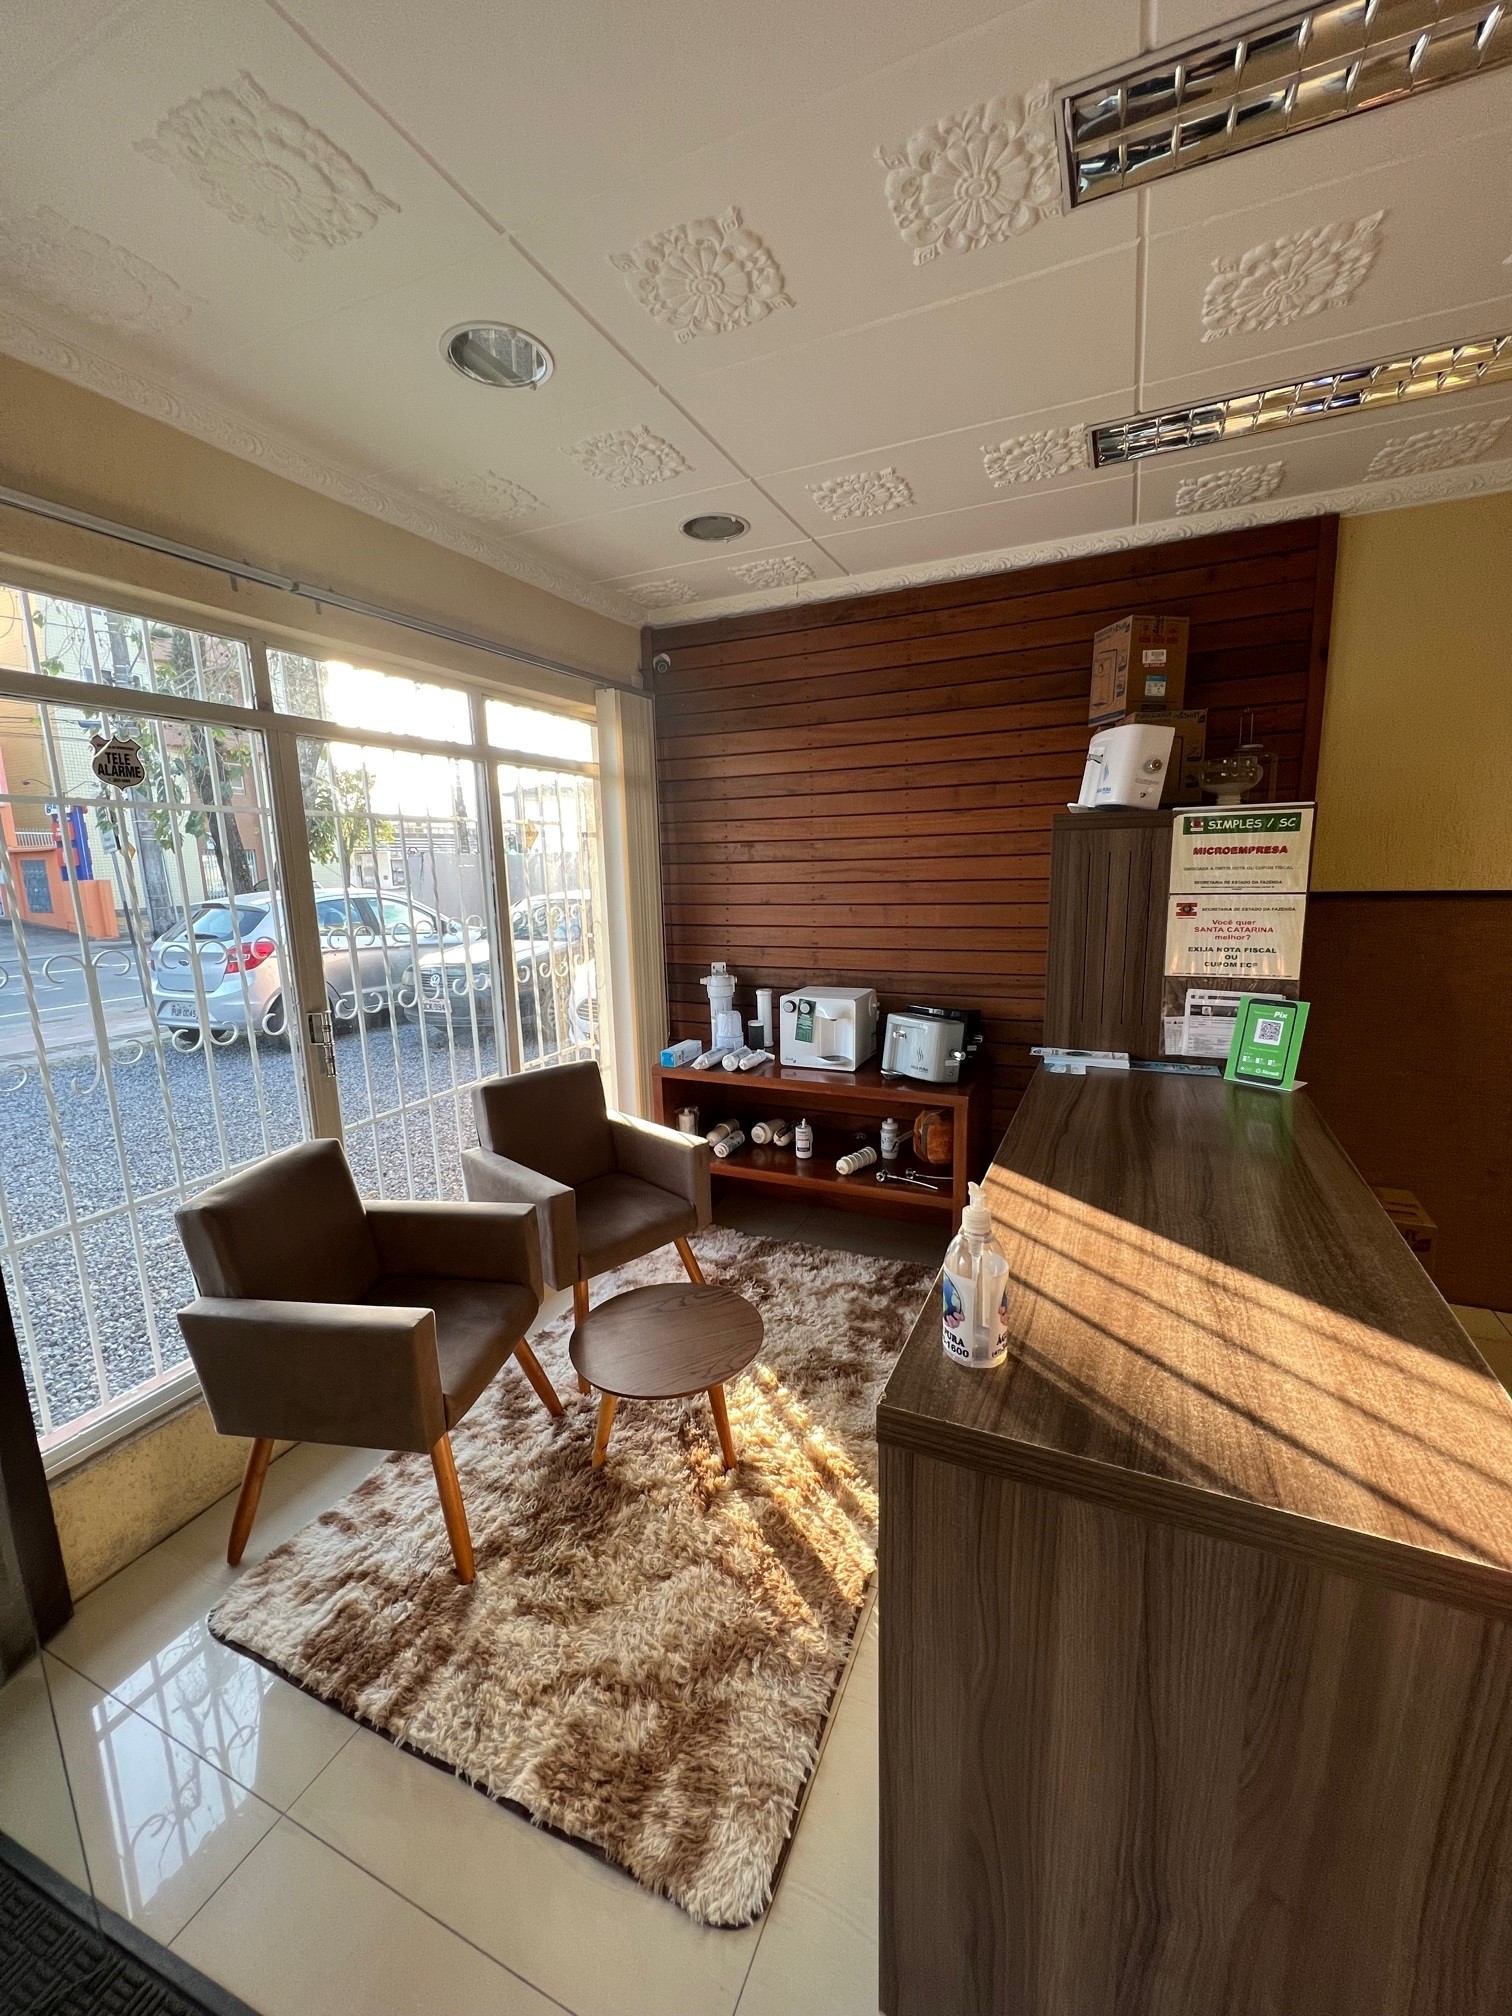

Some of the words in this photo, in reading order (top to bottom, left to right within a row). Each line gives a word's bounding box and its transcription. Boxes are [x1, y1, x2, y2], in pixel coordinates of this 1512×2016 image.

[105, 752, 131, 765] TELE
[97, 763, 142, 778] ALARME
[1207, 818, 1262, 830] SIMPLES
[1278, 817, 1297, 828] SC
[1192, 845, 1289, 856] MICROEMPRESA
[1273, 1011, 1289, 1019] Pix
